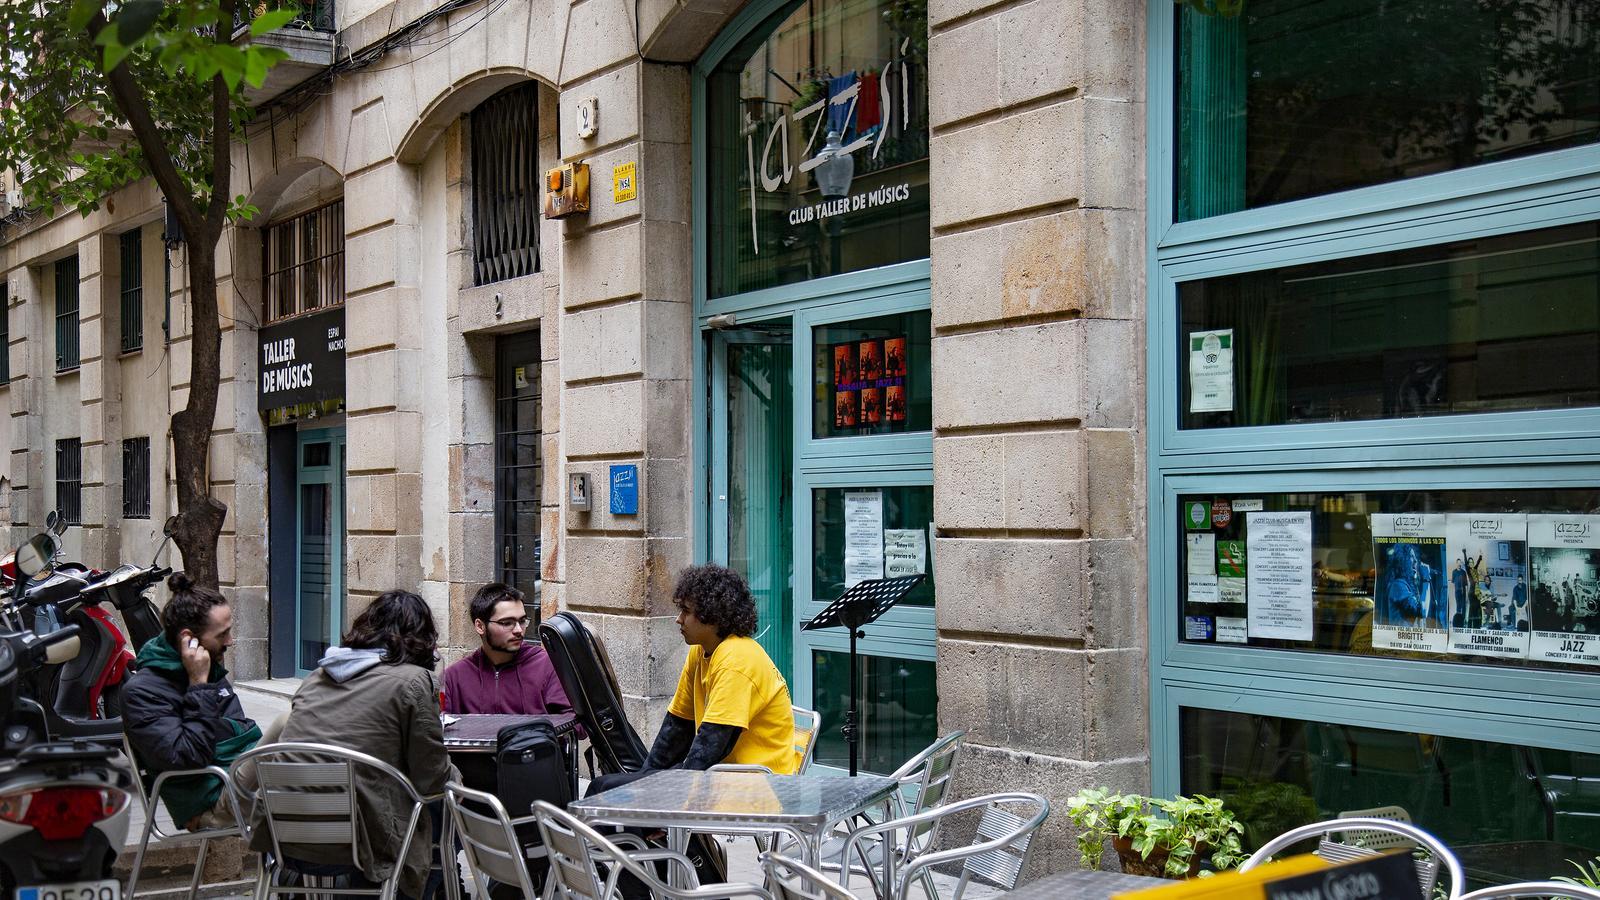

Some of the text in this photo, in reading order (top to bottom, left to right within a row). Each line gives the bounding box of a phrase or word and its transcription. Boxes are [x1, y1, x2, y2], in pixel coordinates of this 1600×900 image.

[582, 106, 589, 130] 2
[789, 183, 910, 226] CLUB TALLER DE MÚSICS
[495, 293, 504, 319] 2
[327, 327, 339, 339] ESPAI
[263, 338, 296, 366] TALLER
[327, 340, 344, 352] NACHO
[263, 361, 313, 394] DE MÚSICS
[1397, 631, 1424, 640] BRIGITTE
[1471, 635, 1504, 645] FLAMENCO
[1560, 640, 1585, 653] JAZZ
